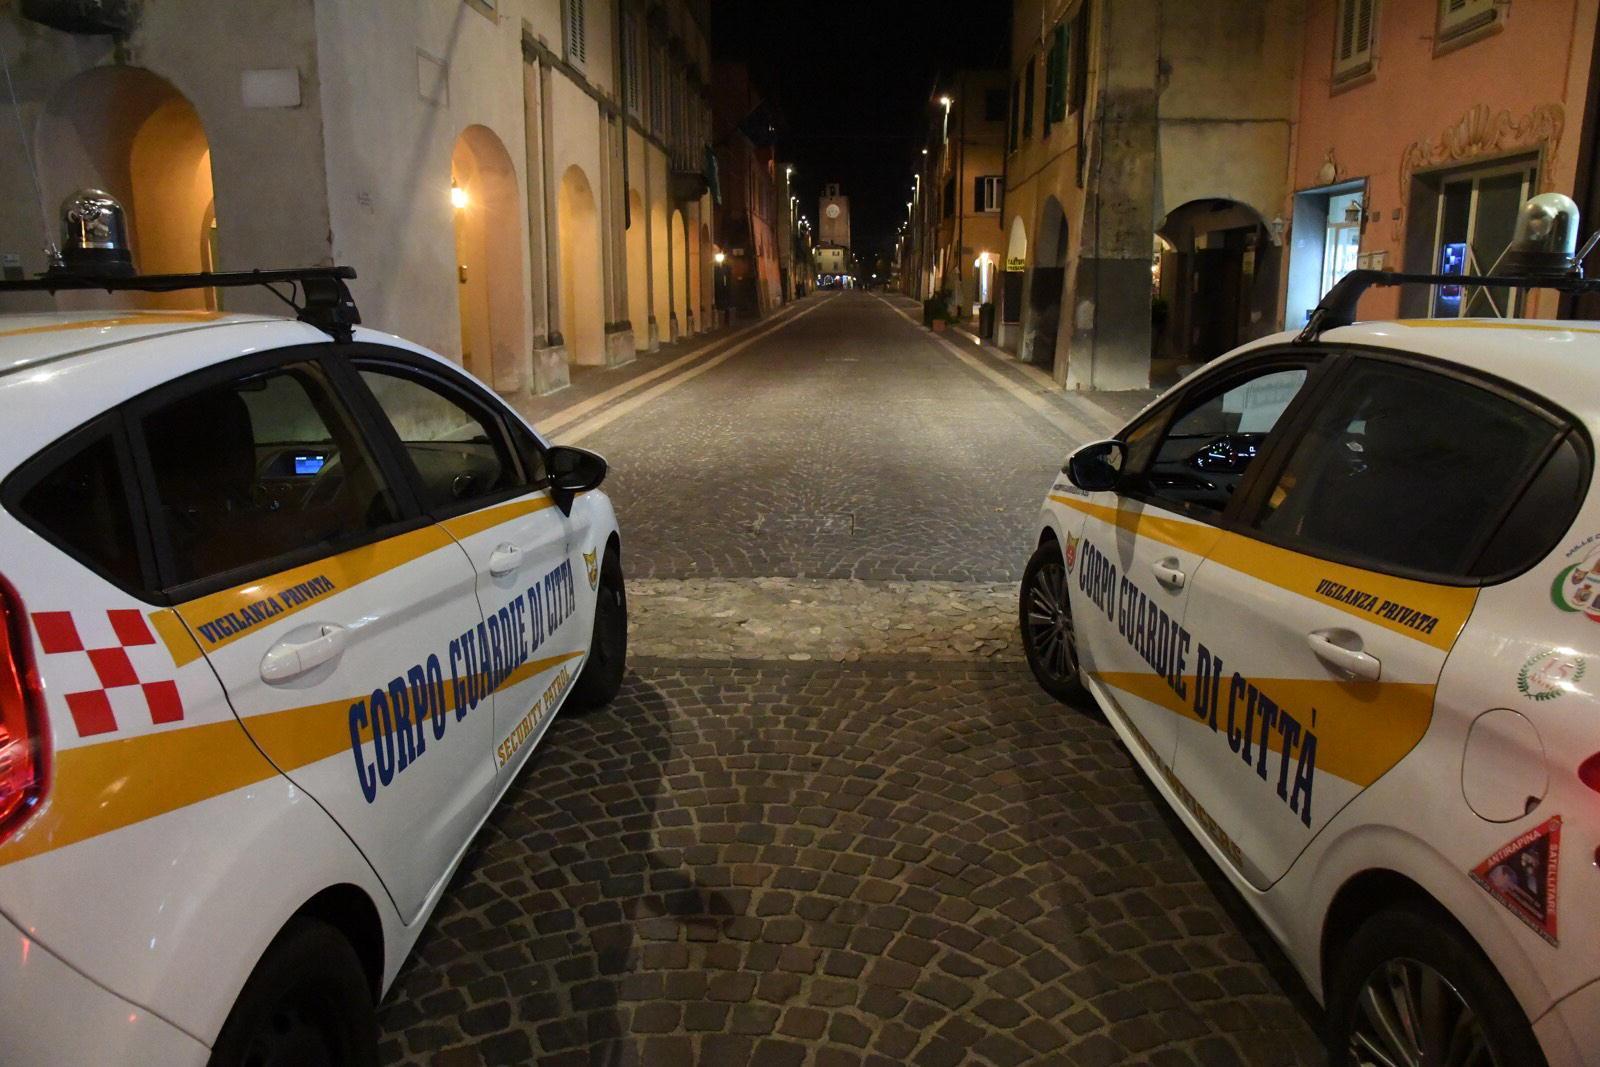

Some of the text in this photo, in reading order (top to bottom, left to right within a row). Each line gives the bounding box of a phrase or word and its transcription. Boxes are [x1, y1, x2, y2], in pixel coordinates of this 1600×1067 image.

[198, 575, 335, 643] VIGILANZA PRIVATA
[1079, 538, 1116, 622] CORPO
[1118, 575, 1191, 701] GUARDIE
[1193, 642, 1223, 733] DI
[1315, 579, 1439, 634] VIGILANZA PRIVATA
[349, 653, 446, 803] CORPO
[449, 594, 527, 722] GUARDIE
[527, 581, 545, 653] DI
[497, 664, 570, 768] SECURITY PATROL
[1487, 829, 1541, 866] ANTIRAPINA
[1547, 843, 1558, 912] SATELLITARE
